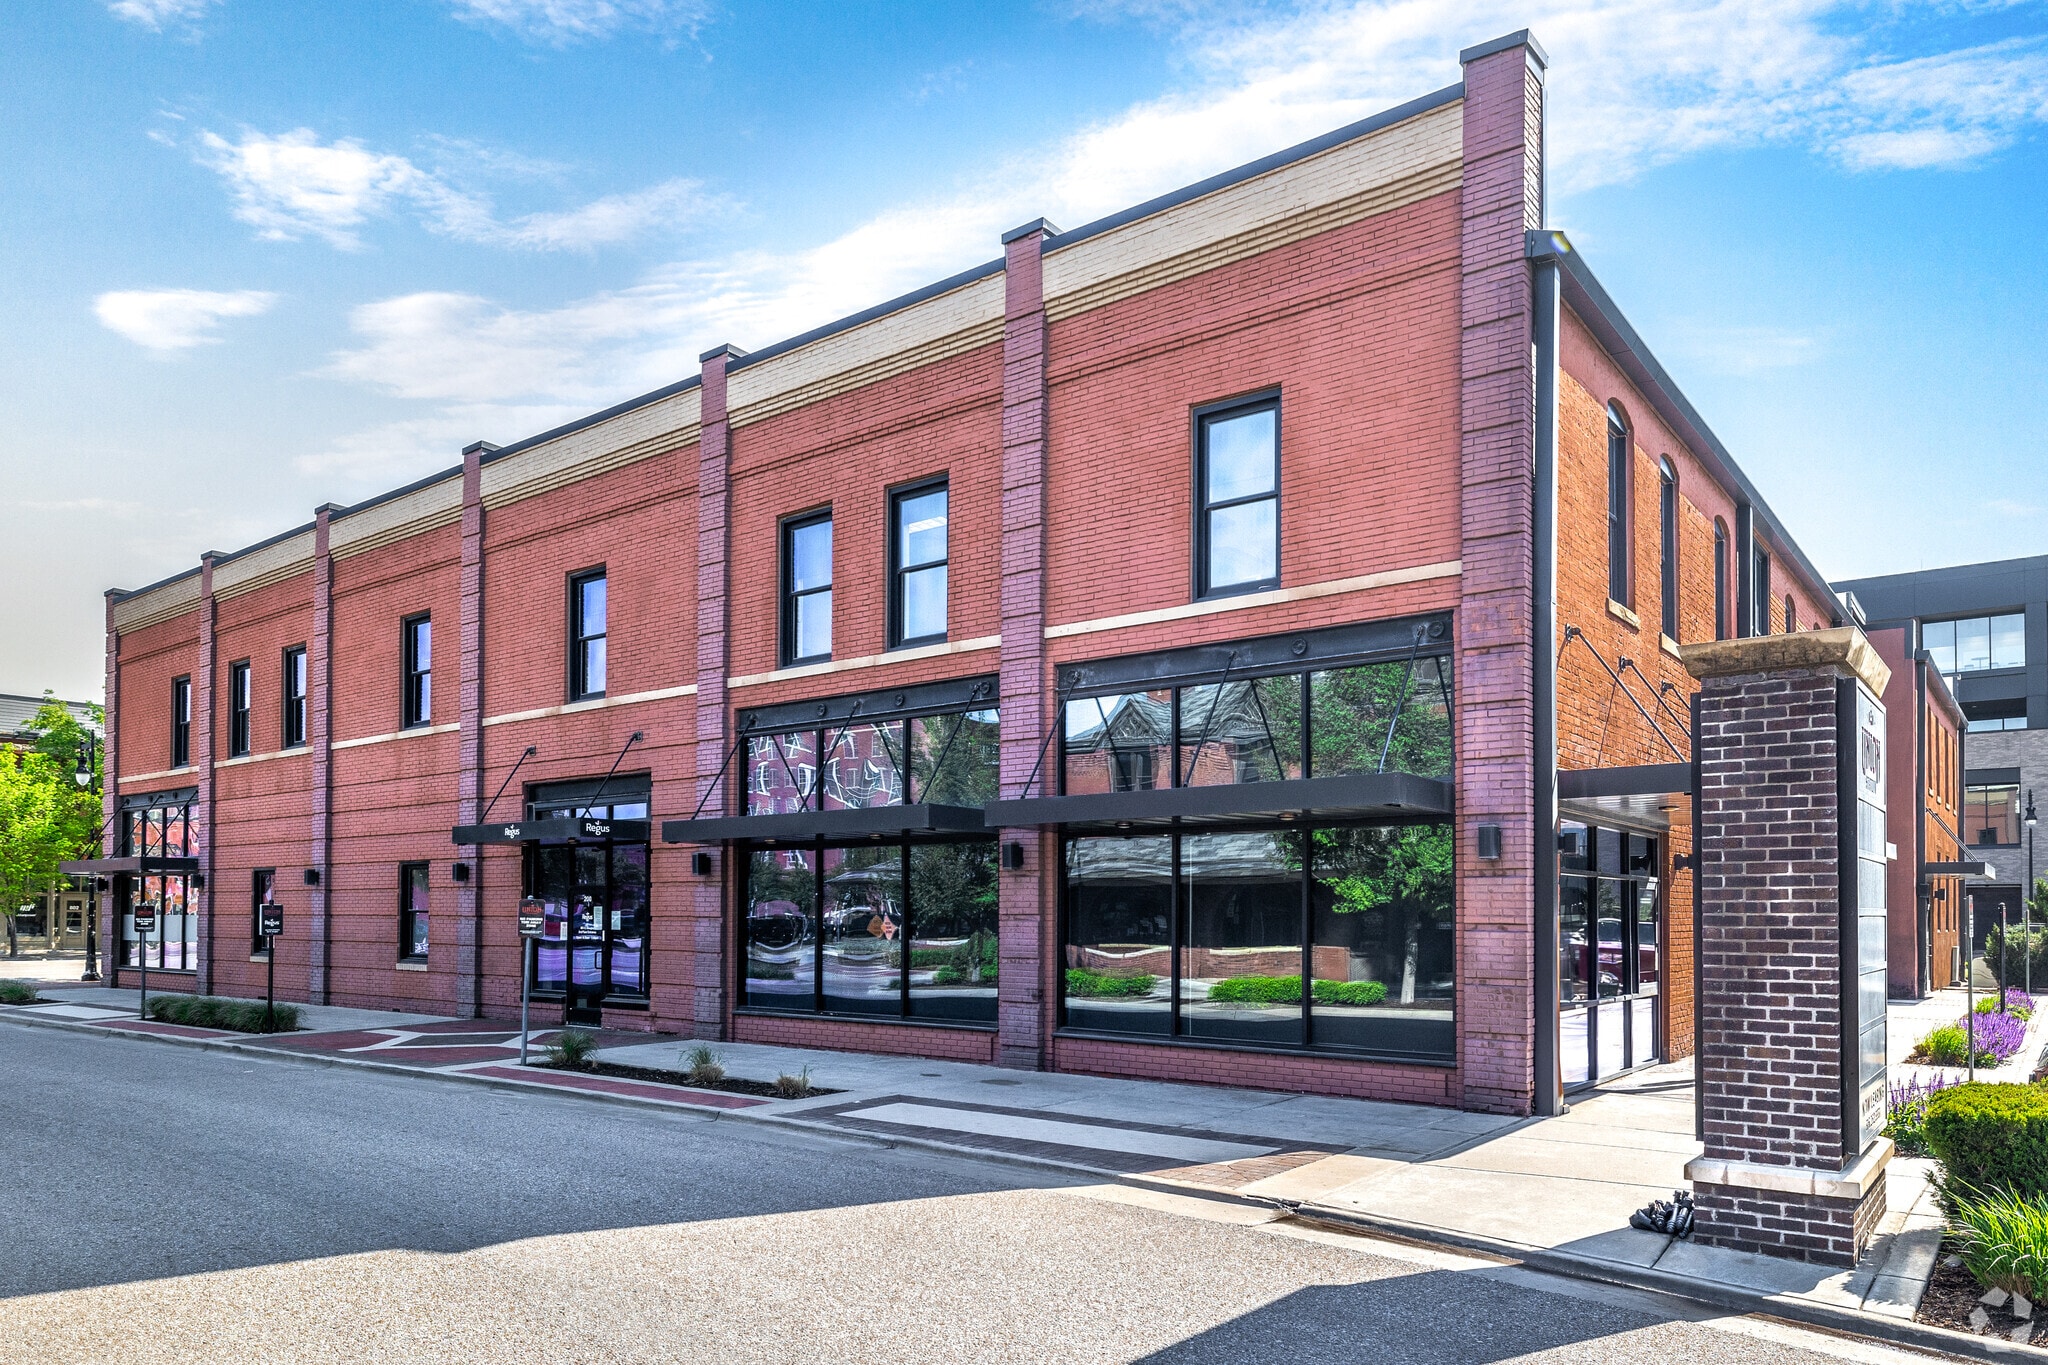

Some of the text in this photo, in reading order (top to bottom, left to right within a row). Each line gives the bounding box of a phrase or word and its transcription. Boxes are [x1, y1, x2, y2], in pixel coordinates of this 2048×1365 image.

[504, 826, 520, 839] Regus
[585, 822, 611, 836] Regus
[264, 919, 280, 927] Regus
